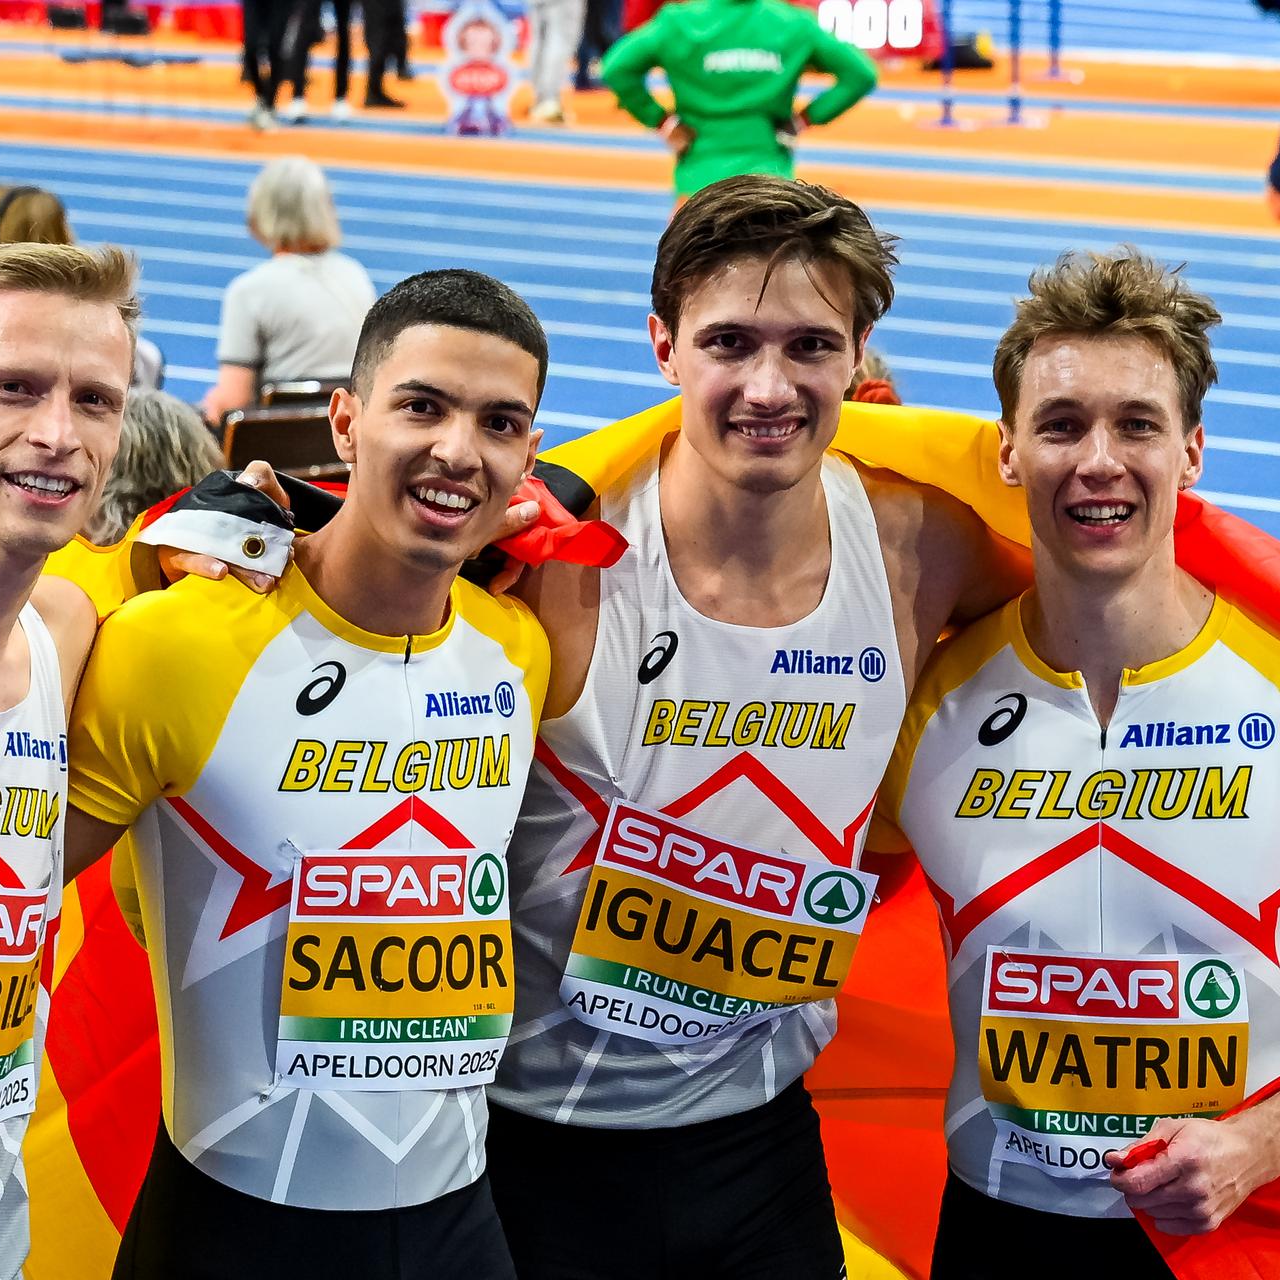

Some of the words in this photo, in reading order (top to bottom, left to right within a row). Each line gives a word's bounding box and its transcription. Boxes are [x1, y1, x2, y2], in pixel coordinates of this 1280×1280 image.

[770, 649, 854, 676] Allianz
[425, 691, 493, 718] Allianz
[641, 698, 857, 751] BELGIUM
[1119, 721, 1231, 749] Allianz
[277, 733, 511, 794] BELGIUM
[954, 764, 1254, 820] BELGIUM
[612, 816, 796, 907] SPAR
[303, 864, 463, 908] SPAR
[585, 879, 839, 988] IGUACEL
[288, 933, 508, 993] SACOOR
[622, 967, 631, 985] I
[634, 971, 688, 1001] RUN
[994, 961, 1174, 1010] SPAR
[339, 1020, 346, 1039] I
[352, 1019, 401, 1039] RUN
[287, 1053, 454, 1078] APELDOORN
[458, 1049, 500, 1075] 2025
[985, 1028, 1238, 1090] WATRIN
[0, 1077, 29, 1107] 2025
[1033, 1111, 1039, 1130] I
[1045, 1111, 1097, 1133] RUN
